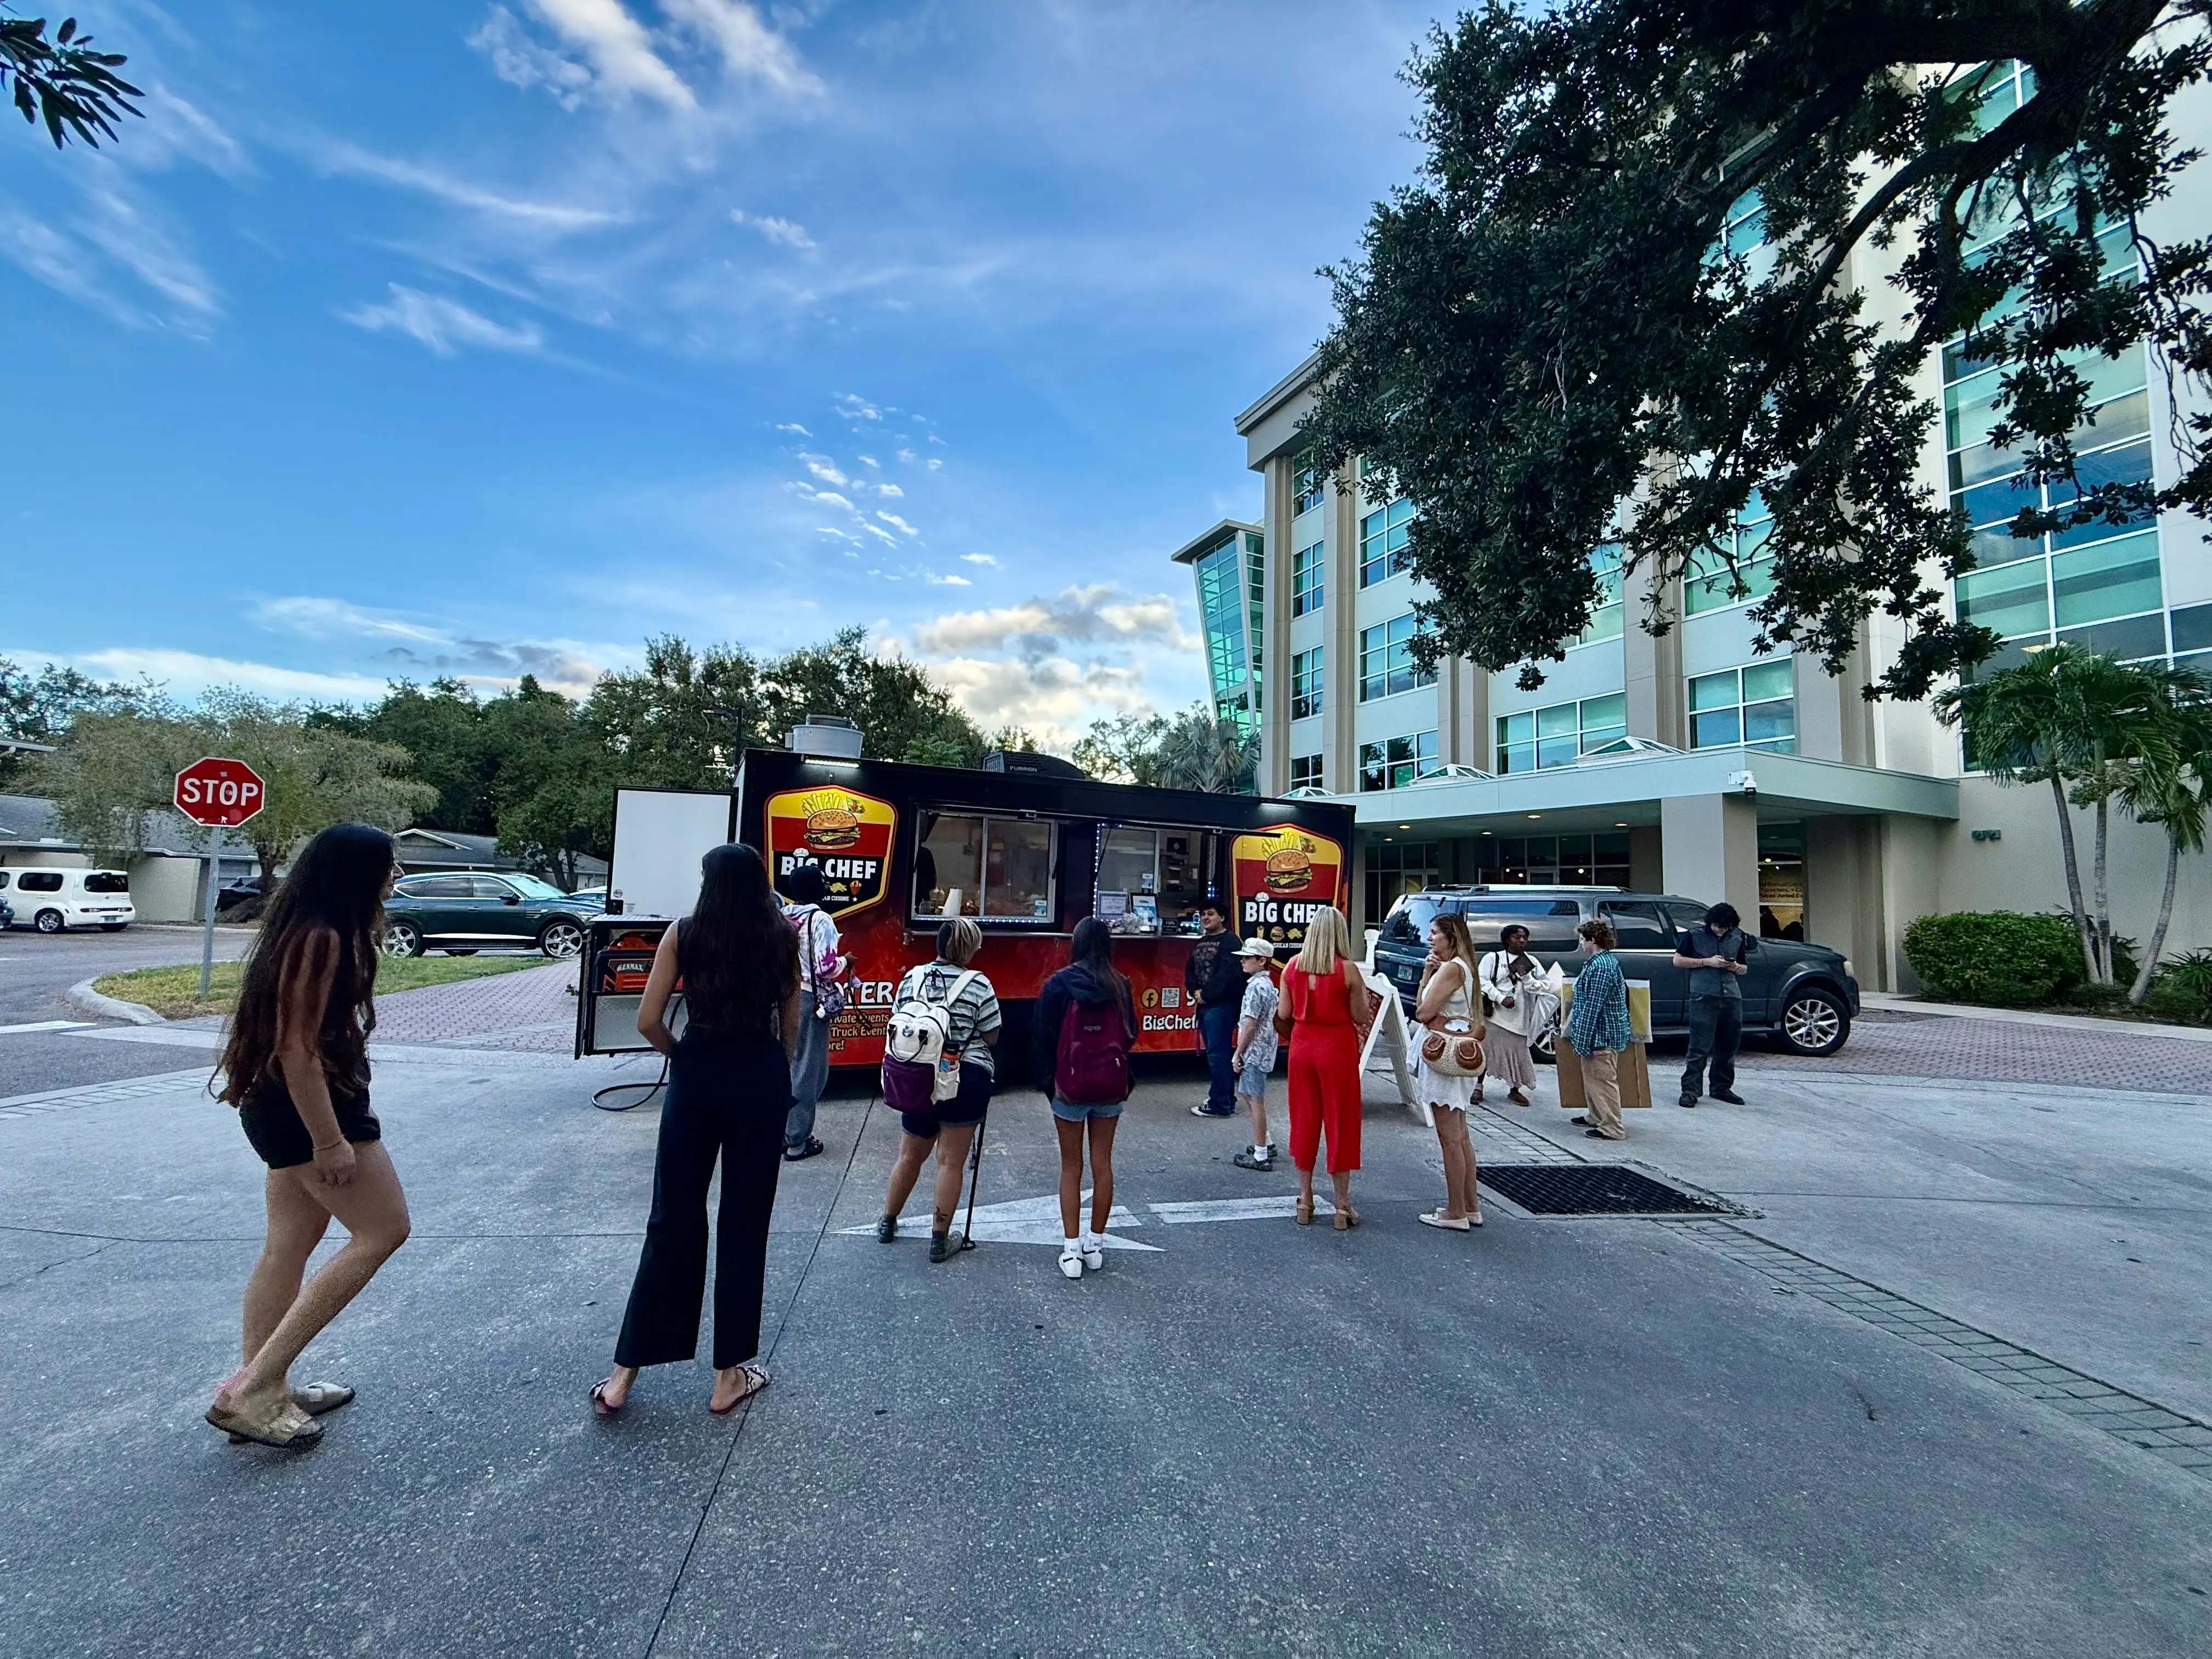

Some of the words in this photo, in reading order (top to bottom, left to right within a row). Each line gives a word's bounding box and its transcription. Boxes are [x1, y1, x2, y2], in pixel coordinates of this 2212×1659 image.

[182, 778, 258, 806] STOP
[825, 859, 876, 879] CHEF
[1245, 901, 1278, 923] BIG
[1283, 903, 1327, 923] CHE
[617, 963, 644, 972] GENMAX
[1143, 1014, 1199, 1030] BigChef
[831, 1026, 858, 1037] Truck
[861, 1026, 887, 1036] Event
